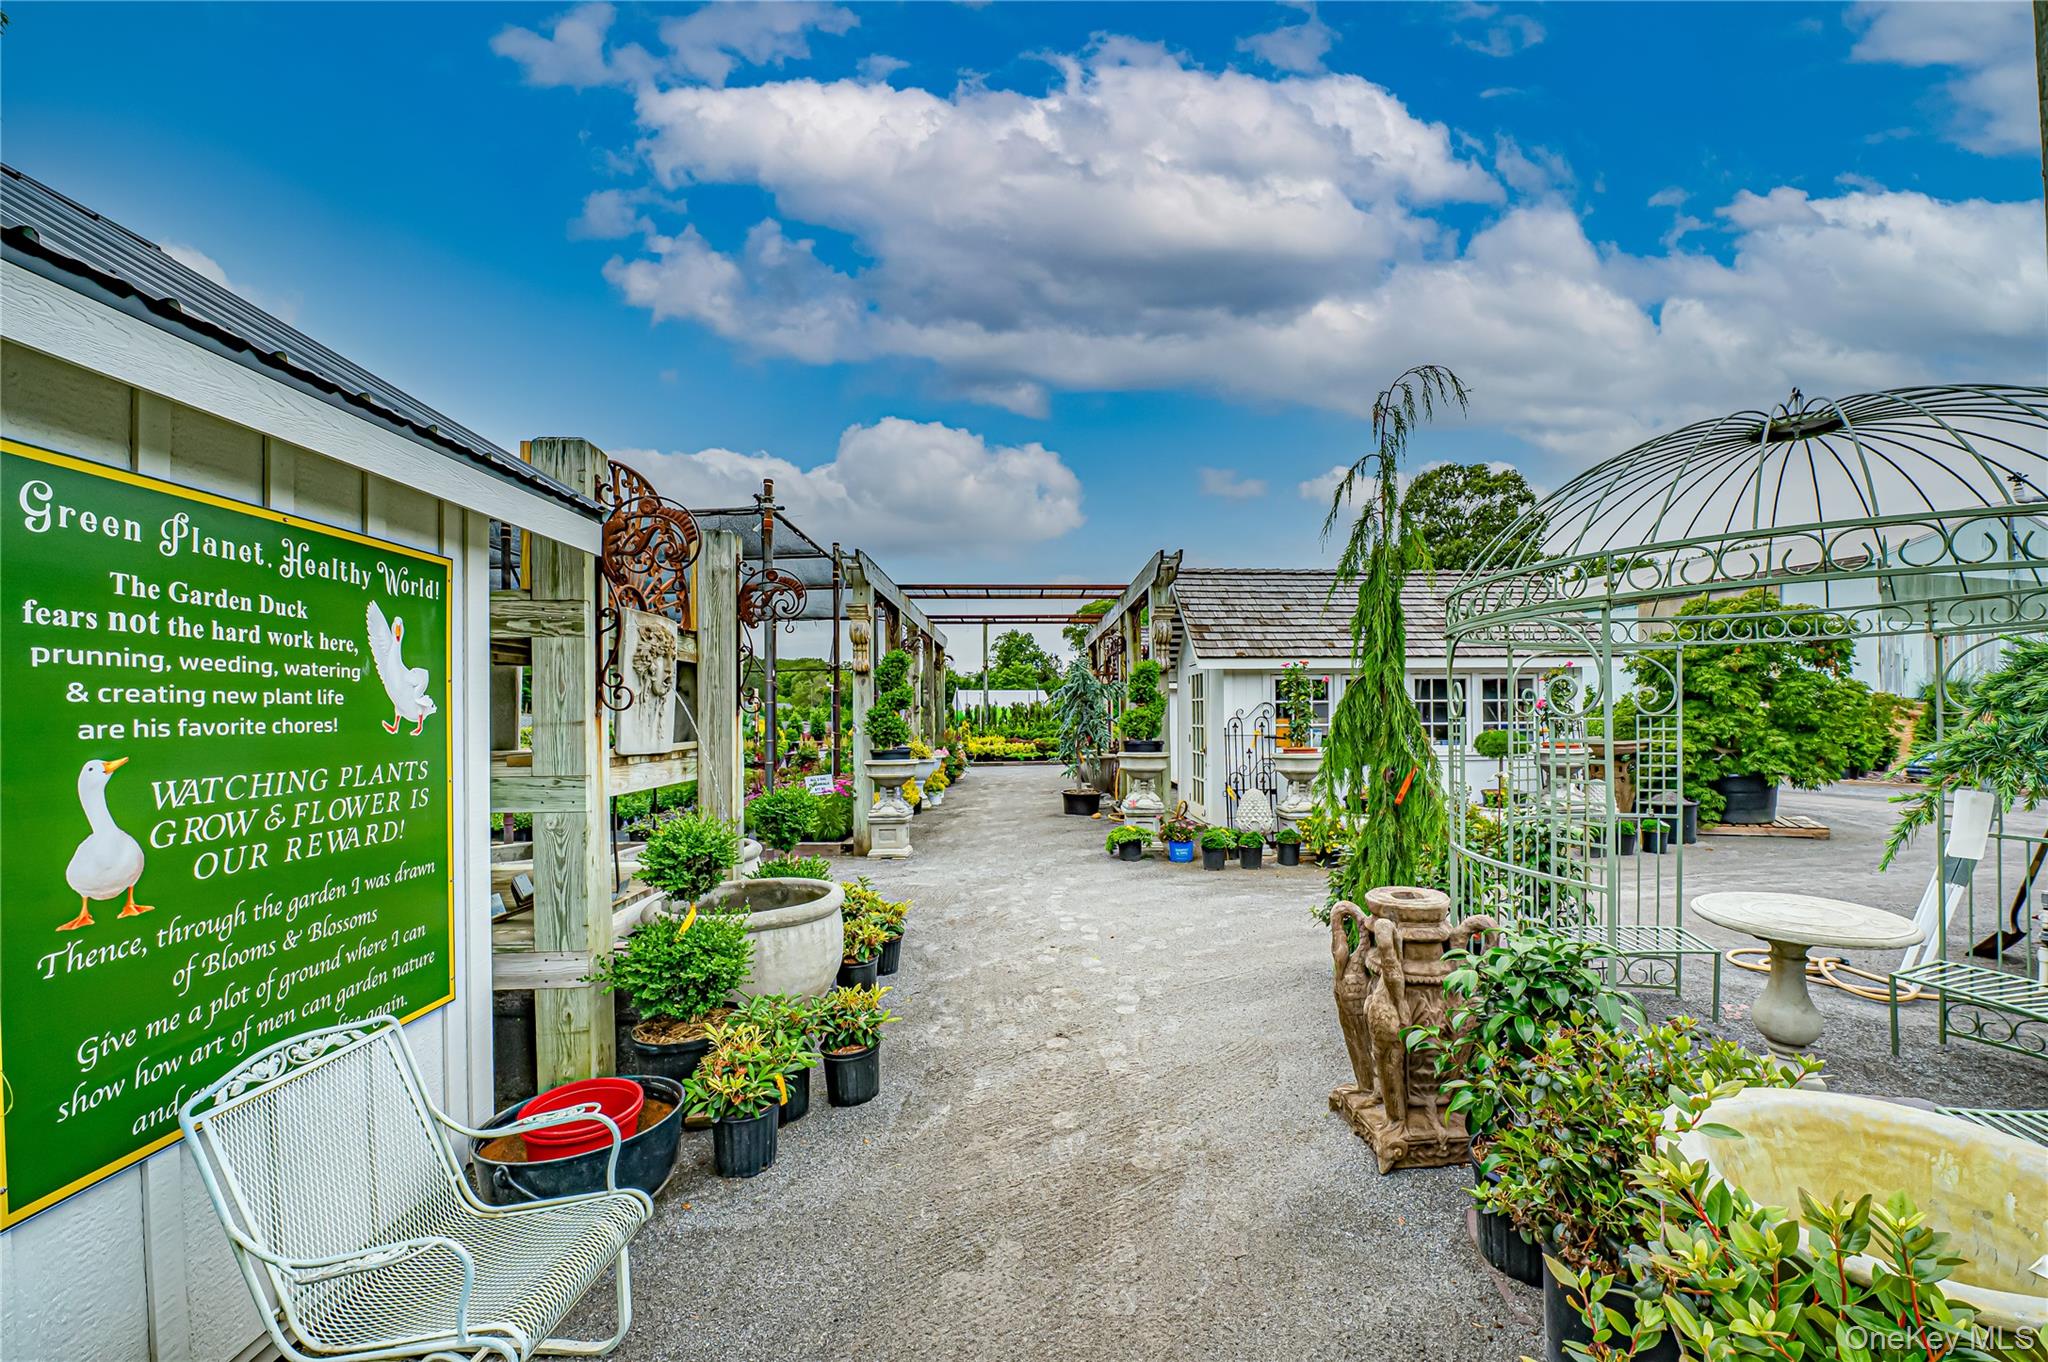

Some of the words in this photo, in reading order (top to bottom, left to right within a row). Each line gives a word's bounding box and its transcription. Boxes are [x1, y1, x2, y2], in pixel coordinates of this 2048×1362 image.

[19, 480, 142, 542] Green
[280, 538, 372, 589] Healthy
[377, 562, 439, 600] World!
[110, 571, 160, 600] The
[168, 581, 252, 612] Garden
[260, 595, 308, 619] Duck
[22, 600, 97, 630] fears
[108, 605, 159, 635] not
[168, 616, 204, 640] the
[212, 620, 260, 643] hard
[267, 629, 314, 649] work
[320, 632, 359, 657] here,
[31, 647, 172, 673] prunning,
[180, 656, 279, 678] weeding,
[284, 662, 361, 683] watering
[66, 682, 88, 703] &
[98, 684, 205, 708] creating
[213, 691, 257, 704] new
[263, 689, 313, 708] plant
[318, 689, 345, 706] life
[78, 724, 125, 740] are
[134, 718, 171, 739] his
[178, 717, 267, 737] favorite
[272, 717, 338, 734] chores!
[150, 768, 329, 811] WATCHING
[339, 761, 428, 788] PLANTS
[149, 809, 259, 850] GROW
[264, 804, 286, 830] &
[292, 791, 401, 829] FLOWER
[410, 788, 430, 808] IS
[194, 843, 268, 880] OUR
[284, 820, 406, 863] REWARD!
[36, 940, 148, 980] Thence,
[156, 910, 247, 944] through
[253, 892, 283, 922] the
[285, 882, 347, 923] garden
[351, 876, 362, 895] I
[364, 875, 391, 891] was
[394, 859, 436, 883] drawn
[172, 967, 197, 998] of
[201, 943, 277, 978] Blooms
[282, 929, 304, 951] &
[308, 907, 378, 943] Blossoms
[75, 1034, 137, 1073] Give
[145, 1018, 181, 1040] me
[189, 1005, 204, 1024] a
[203, 980, 250, 1030] plot
[256, 967, 278, 1009] of
[278, 952, 342, 1001] ground
[345, 934, 389, 963] where
[391, 929, 401, 949] I
[402, 922, 427, 943] can
[56, 1079, 127, 1123] show
[134, 1055, 183, 1090] how
[189, 1036, 225, 1067] art
[230, 1017, 257, 1057] of
[256, 1004, 296, 1038] men
[300, 991, 333, 1018] can
[334, 967, 390, 1014] garden
[391, 950, 435, 981] nature
[132, 1084, 187, 1136] and
